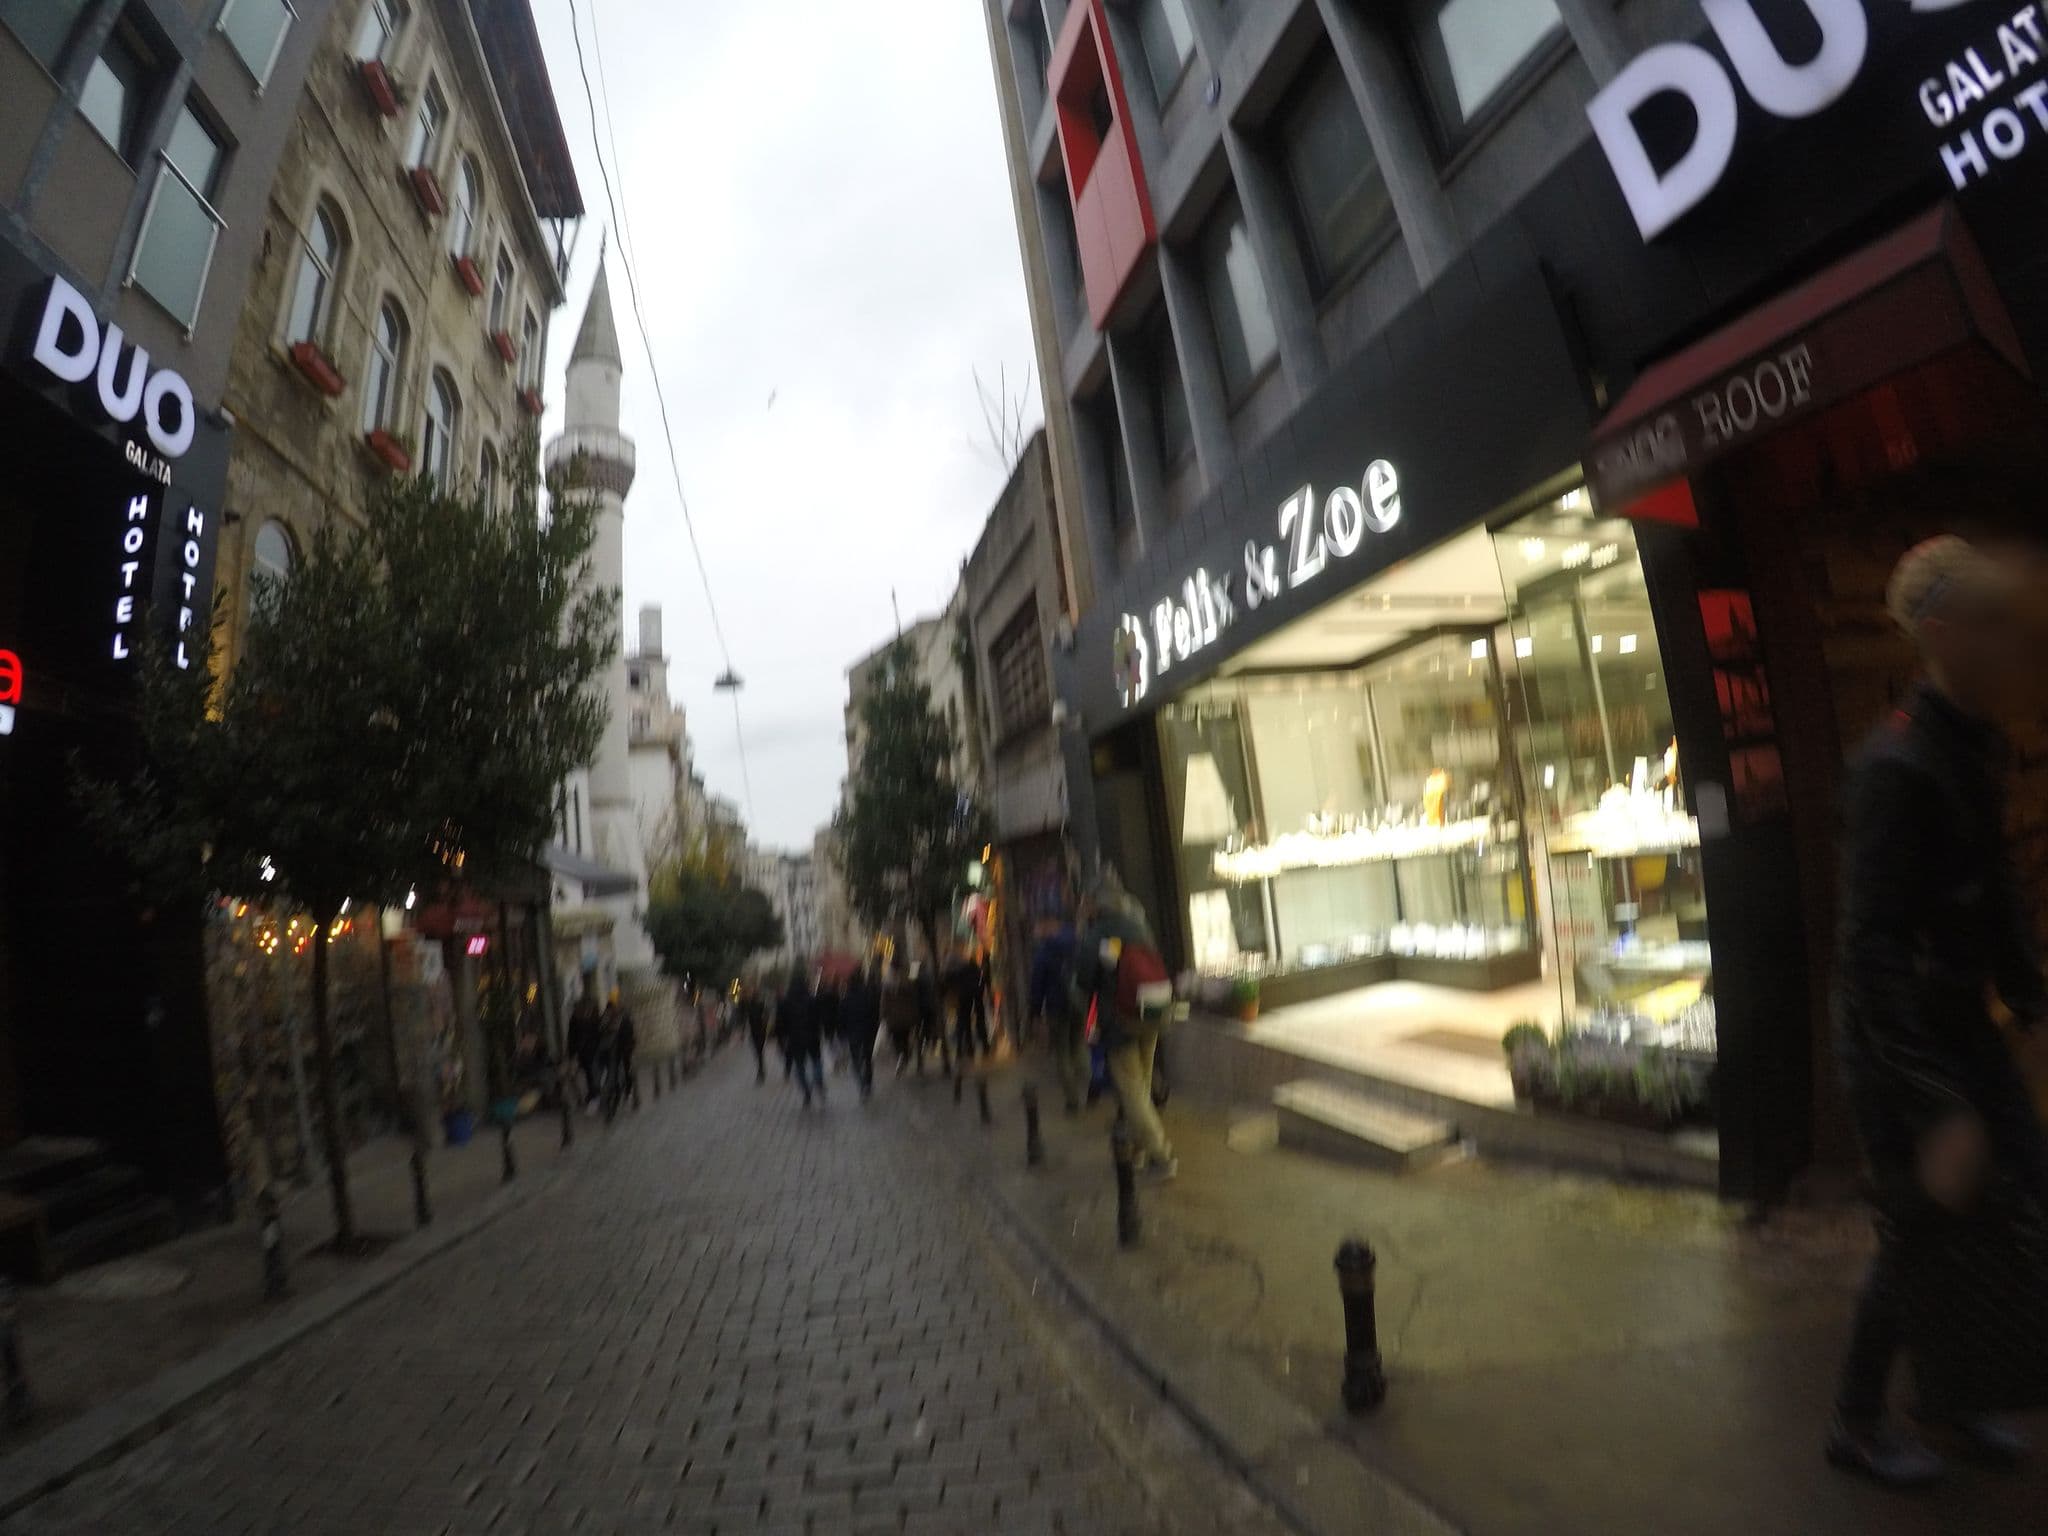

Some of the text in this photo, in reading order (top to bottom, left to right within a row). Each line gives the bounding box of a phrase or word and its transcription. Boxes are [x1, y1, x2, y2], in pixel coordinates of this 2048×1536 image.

[1586, 0, 1972, 245] DU
[1919, 0, 2048, 127] GALAT
[33, 273, 196, 458] DUO
[126, 440, 172, 487] GALATA
[113, 495, 148, 660] HOTEL
[176, 506, 204, 671] HOTEL
[1150, 458, 1401, 676] Felix & Zoe
